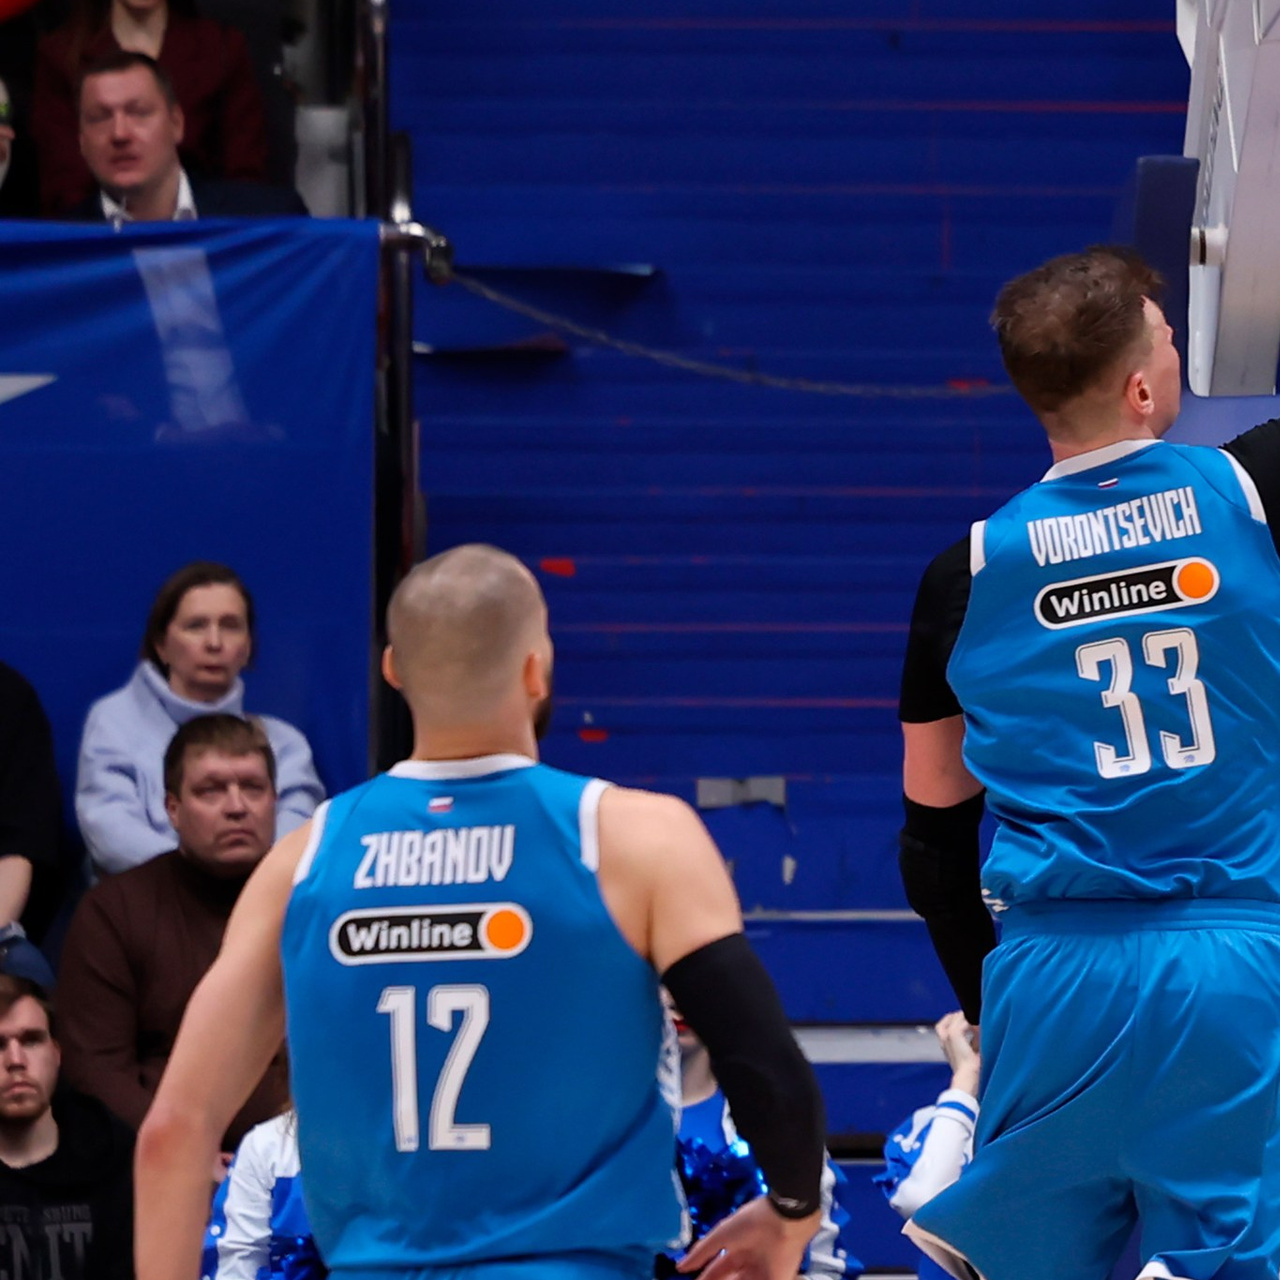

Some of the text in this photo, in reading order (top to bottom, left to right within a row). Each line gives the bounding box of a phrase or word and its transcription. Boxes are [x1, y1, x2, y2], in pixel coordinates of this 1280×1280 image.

[1026, 486, 1203, 568] VORONTSEVICH
[1049, 577, 1168, 619] Winline
[1075, 627, 1216, 780] 33
[353, 824, 516, 890] ZHBANOV
[345, 921, 473, 953] Winline
[375, 983, 491, 1153] 12
